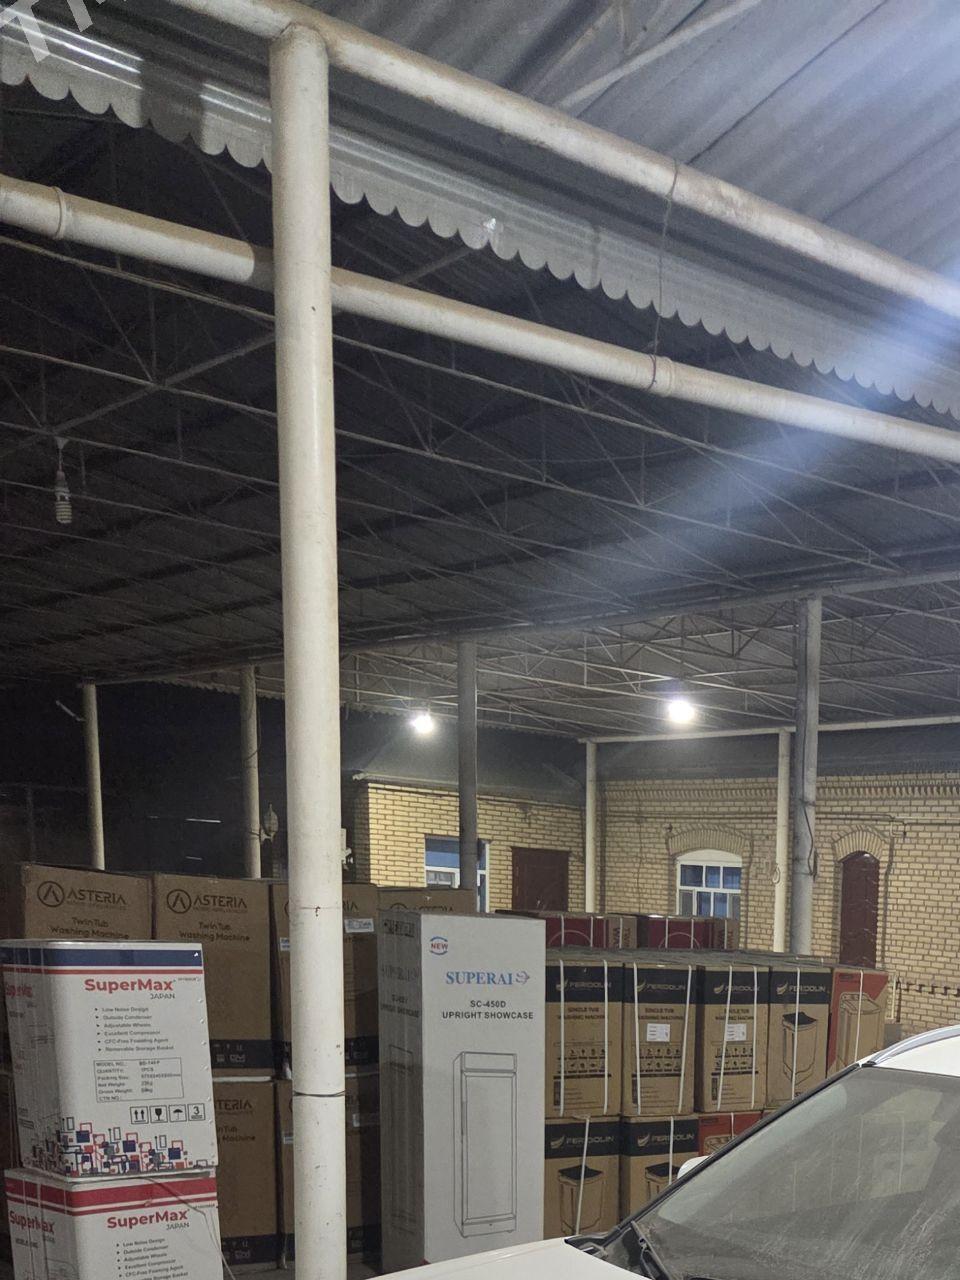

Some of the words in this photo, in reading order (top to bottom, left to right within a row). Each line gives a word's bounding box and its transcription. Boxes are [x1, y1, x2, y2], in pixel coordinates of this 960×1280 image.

[67, 888, 127, 905] ASTERIA
[193, 894, 247, 908] ASTERIA
[49, 925, 90, 938] Washing
[91, 929, 130, 940] Machine
[430, 942, 448, 950] NEW
[84, 978, 174, 994] SuperMax
[470, 1000, 507, 1008] SC-450D
[442, 1011, 482, 1020] UPRIGHT
[484, 1011, 534, 1020] SHOWCASE
[107, 1210, 188, 1230] SuperMax
[166, 1222, 190, 1231] JAPAN
